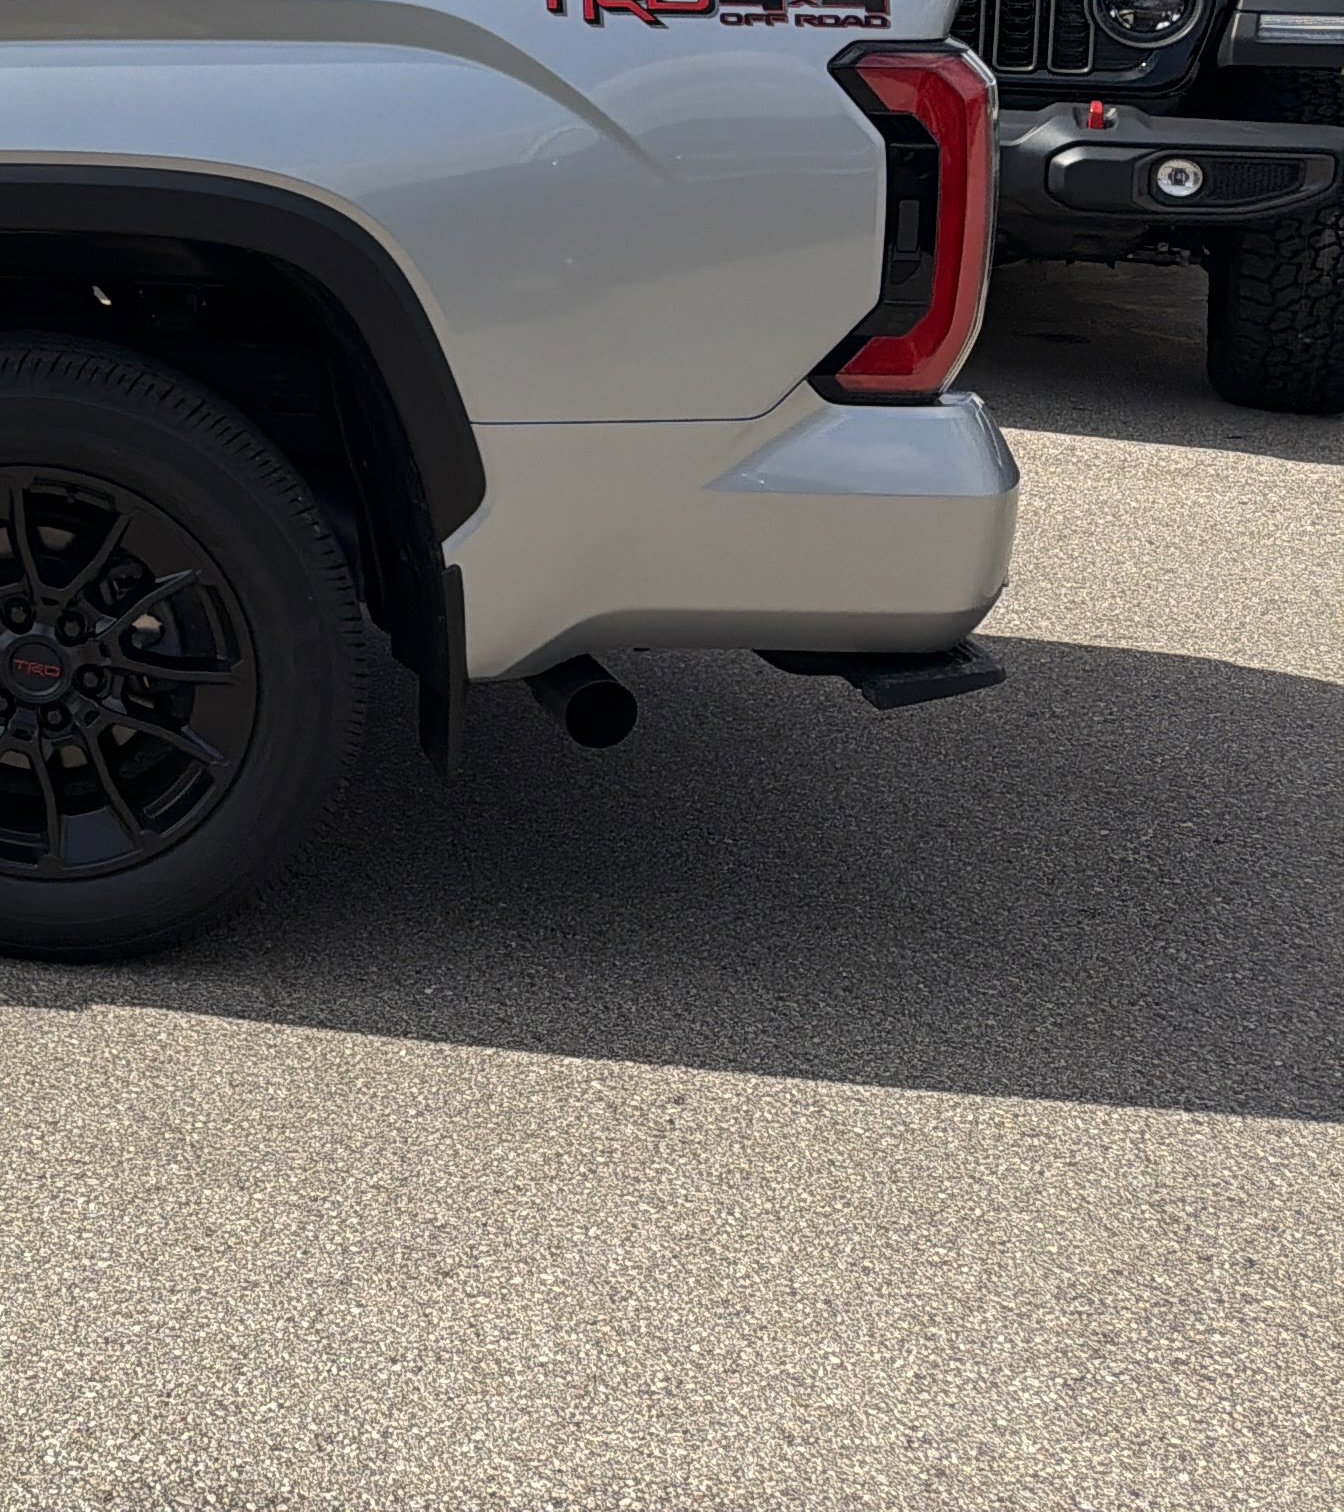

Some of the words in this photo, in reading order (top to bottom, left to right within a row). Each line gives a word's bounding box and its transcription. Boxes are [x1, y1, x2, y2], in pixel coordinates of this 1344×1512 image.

[719, 14, 789, 27] OFF
[794, 14, 892, 29] ROAD
[14, 660, 62, 678] TRD
